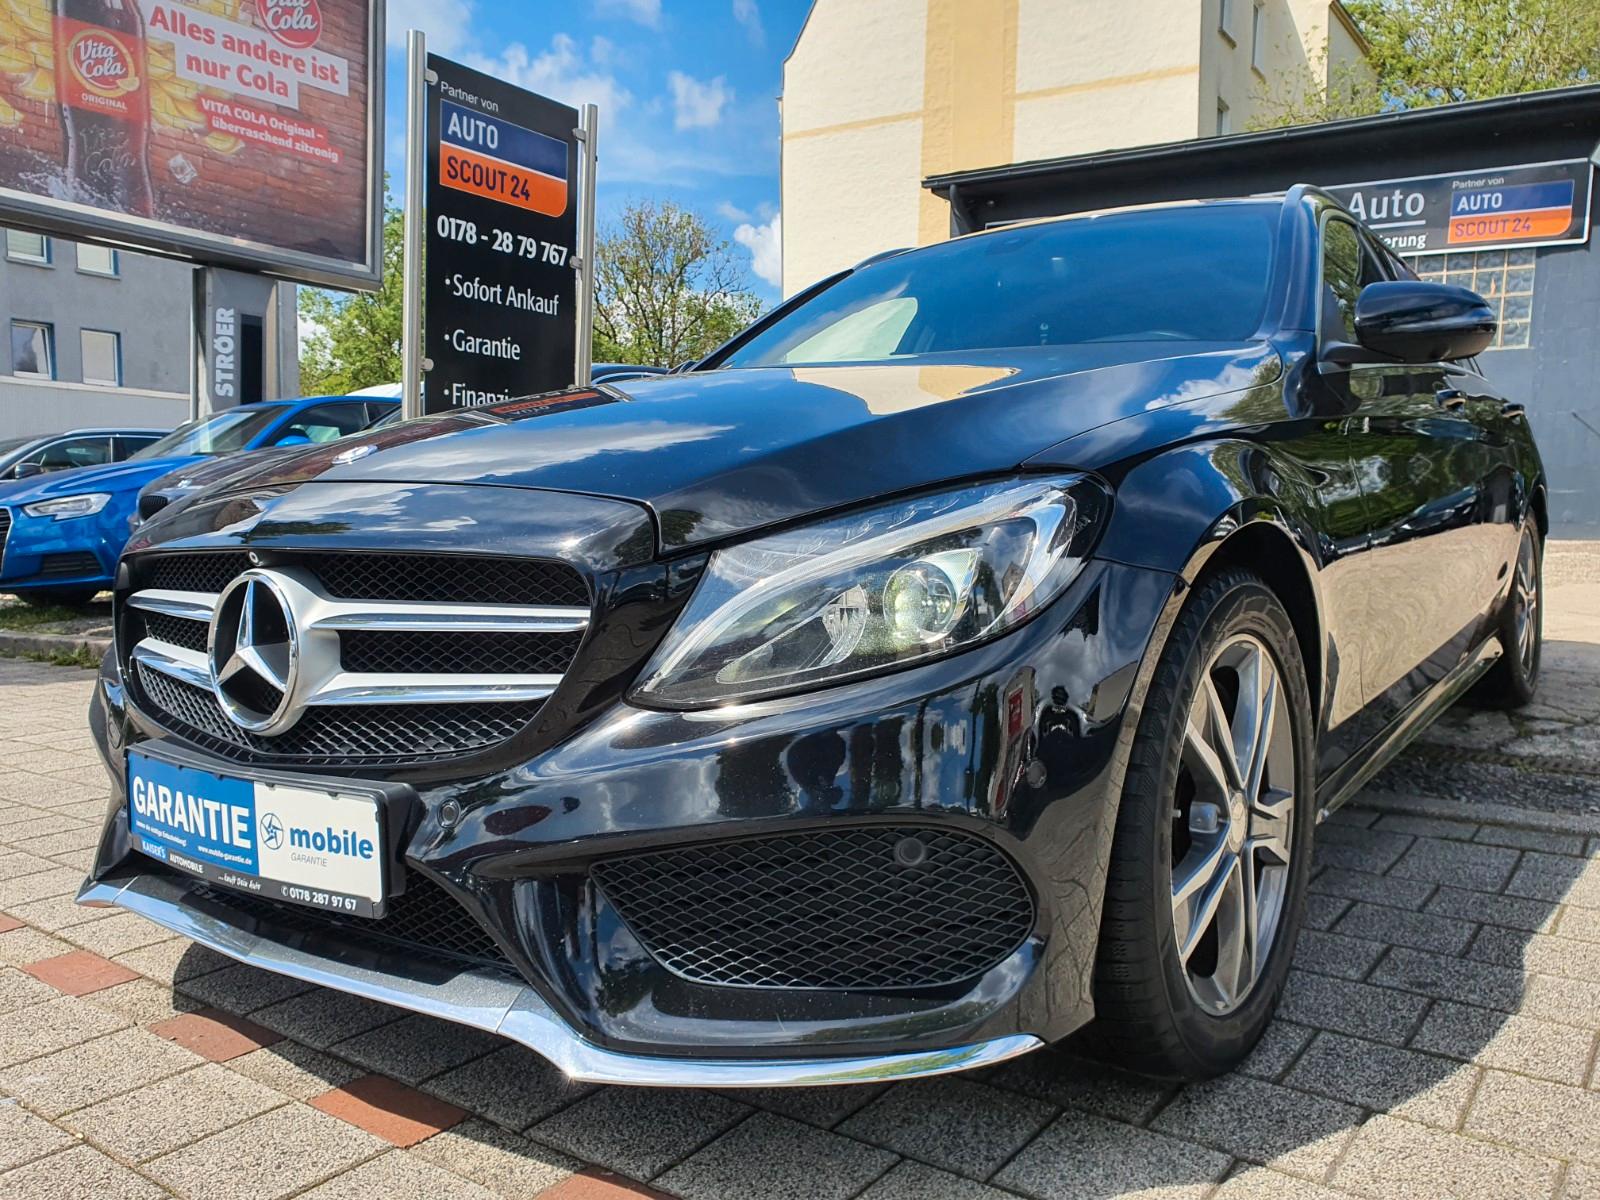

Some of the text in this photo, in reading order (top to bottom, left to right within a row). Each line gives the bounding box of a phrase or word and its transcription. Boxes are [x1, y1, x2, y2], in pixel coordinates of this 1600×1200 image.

[267, 6, 318, 30] Cola
[77, 39, 118, 61] Vita
[150, 5, 340, 84] Alles andere ist
[81, 57, 126, 78] Cola
[186, 54, 289, 98] nur Cola
[81, 93, 128, 110] ORIGINAL
[440, 81, 499, 112] Partner von
[201, 98, 232, 116] VITA
[234, 108, 267, 126] COLA
[269, 117, 315, 138] Original
[448, 112, 498, 149] AUTO
[212, 115, 339, 163] überraschend zitronig
[1452, 177, 1504, 189] Partner von
[1348, 189, 1425, 220] Auto
[1457, 192, 1503, 211] AUTO
[437, 214, 477, 244] 0178
[492, 228, 513, 253] 28
[517, 234, 537, 258] 79
[540, 241, 568, 266] 767
[453, 274, 559, 316] Sofort Ankauf
[213, 307, 235, 397] STRÖER
[452, 329, 520, 360] Garantie
[133, 776, 251, 849] GARANTIE
[290, 827, 374, 859] mobile
[170, 853, 204, 874] AUTOMOBILE
[291, 852, 328, 867] GARANTIE
[289, 887, 357, 911] 0178 287 97 67
